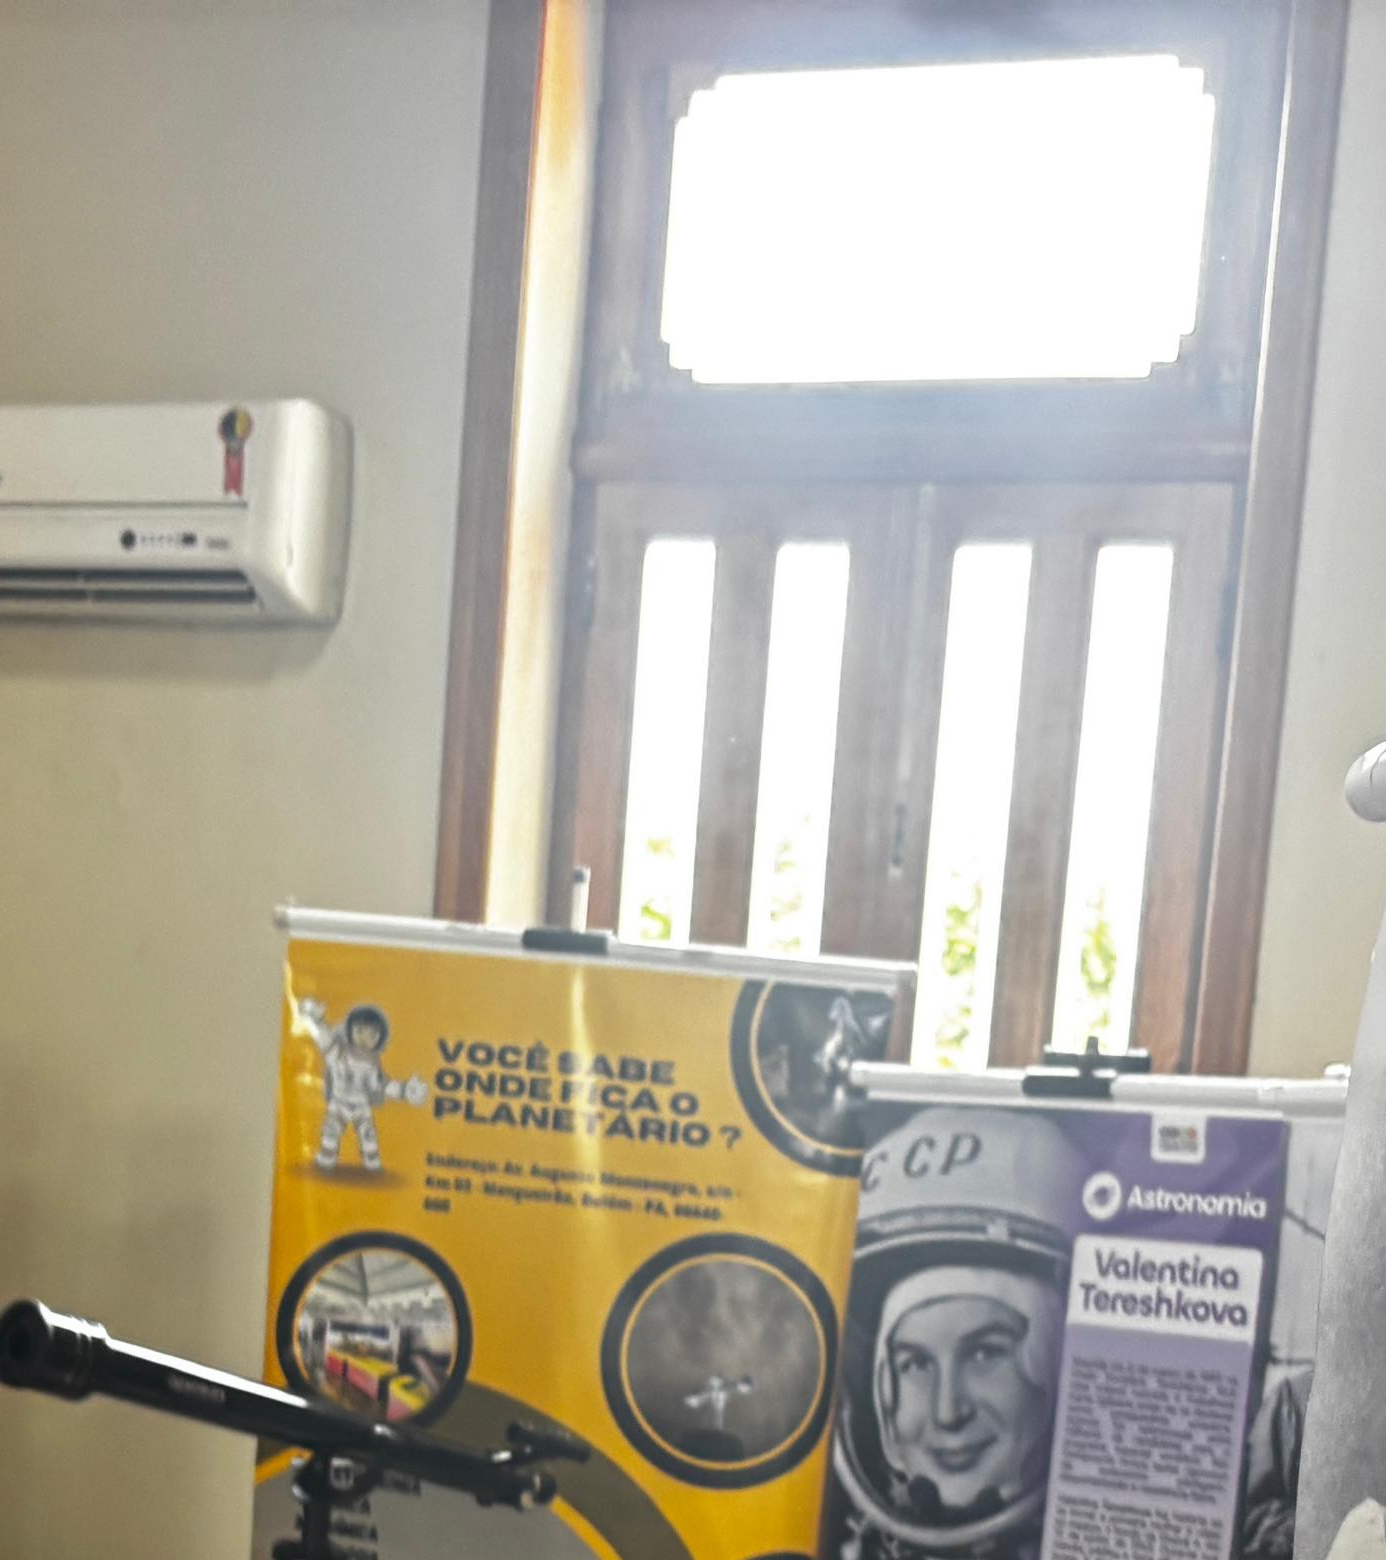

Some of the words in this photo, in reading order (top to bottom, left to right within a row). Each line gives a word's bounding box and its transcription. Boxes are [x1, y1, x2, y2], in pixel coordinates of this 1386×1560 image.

[438, 1039, 550, 1073] VOCÊ
[557, 1051, 676, 1086] SABE
[434, 1068, 552, 1101] ONDE
[561, 1080, 659, 1112] FICA
[670, 1092, 699, 1116] O
[433, 1097, 710, 1148] PLANETÁRIO
[1127, 1185, 1267, 1219] Astronomia
[1095, 1248, 1239, 1290] Valentina
[1079, 1281, 1247, 1327] Tereshkova
